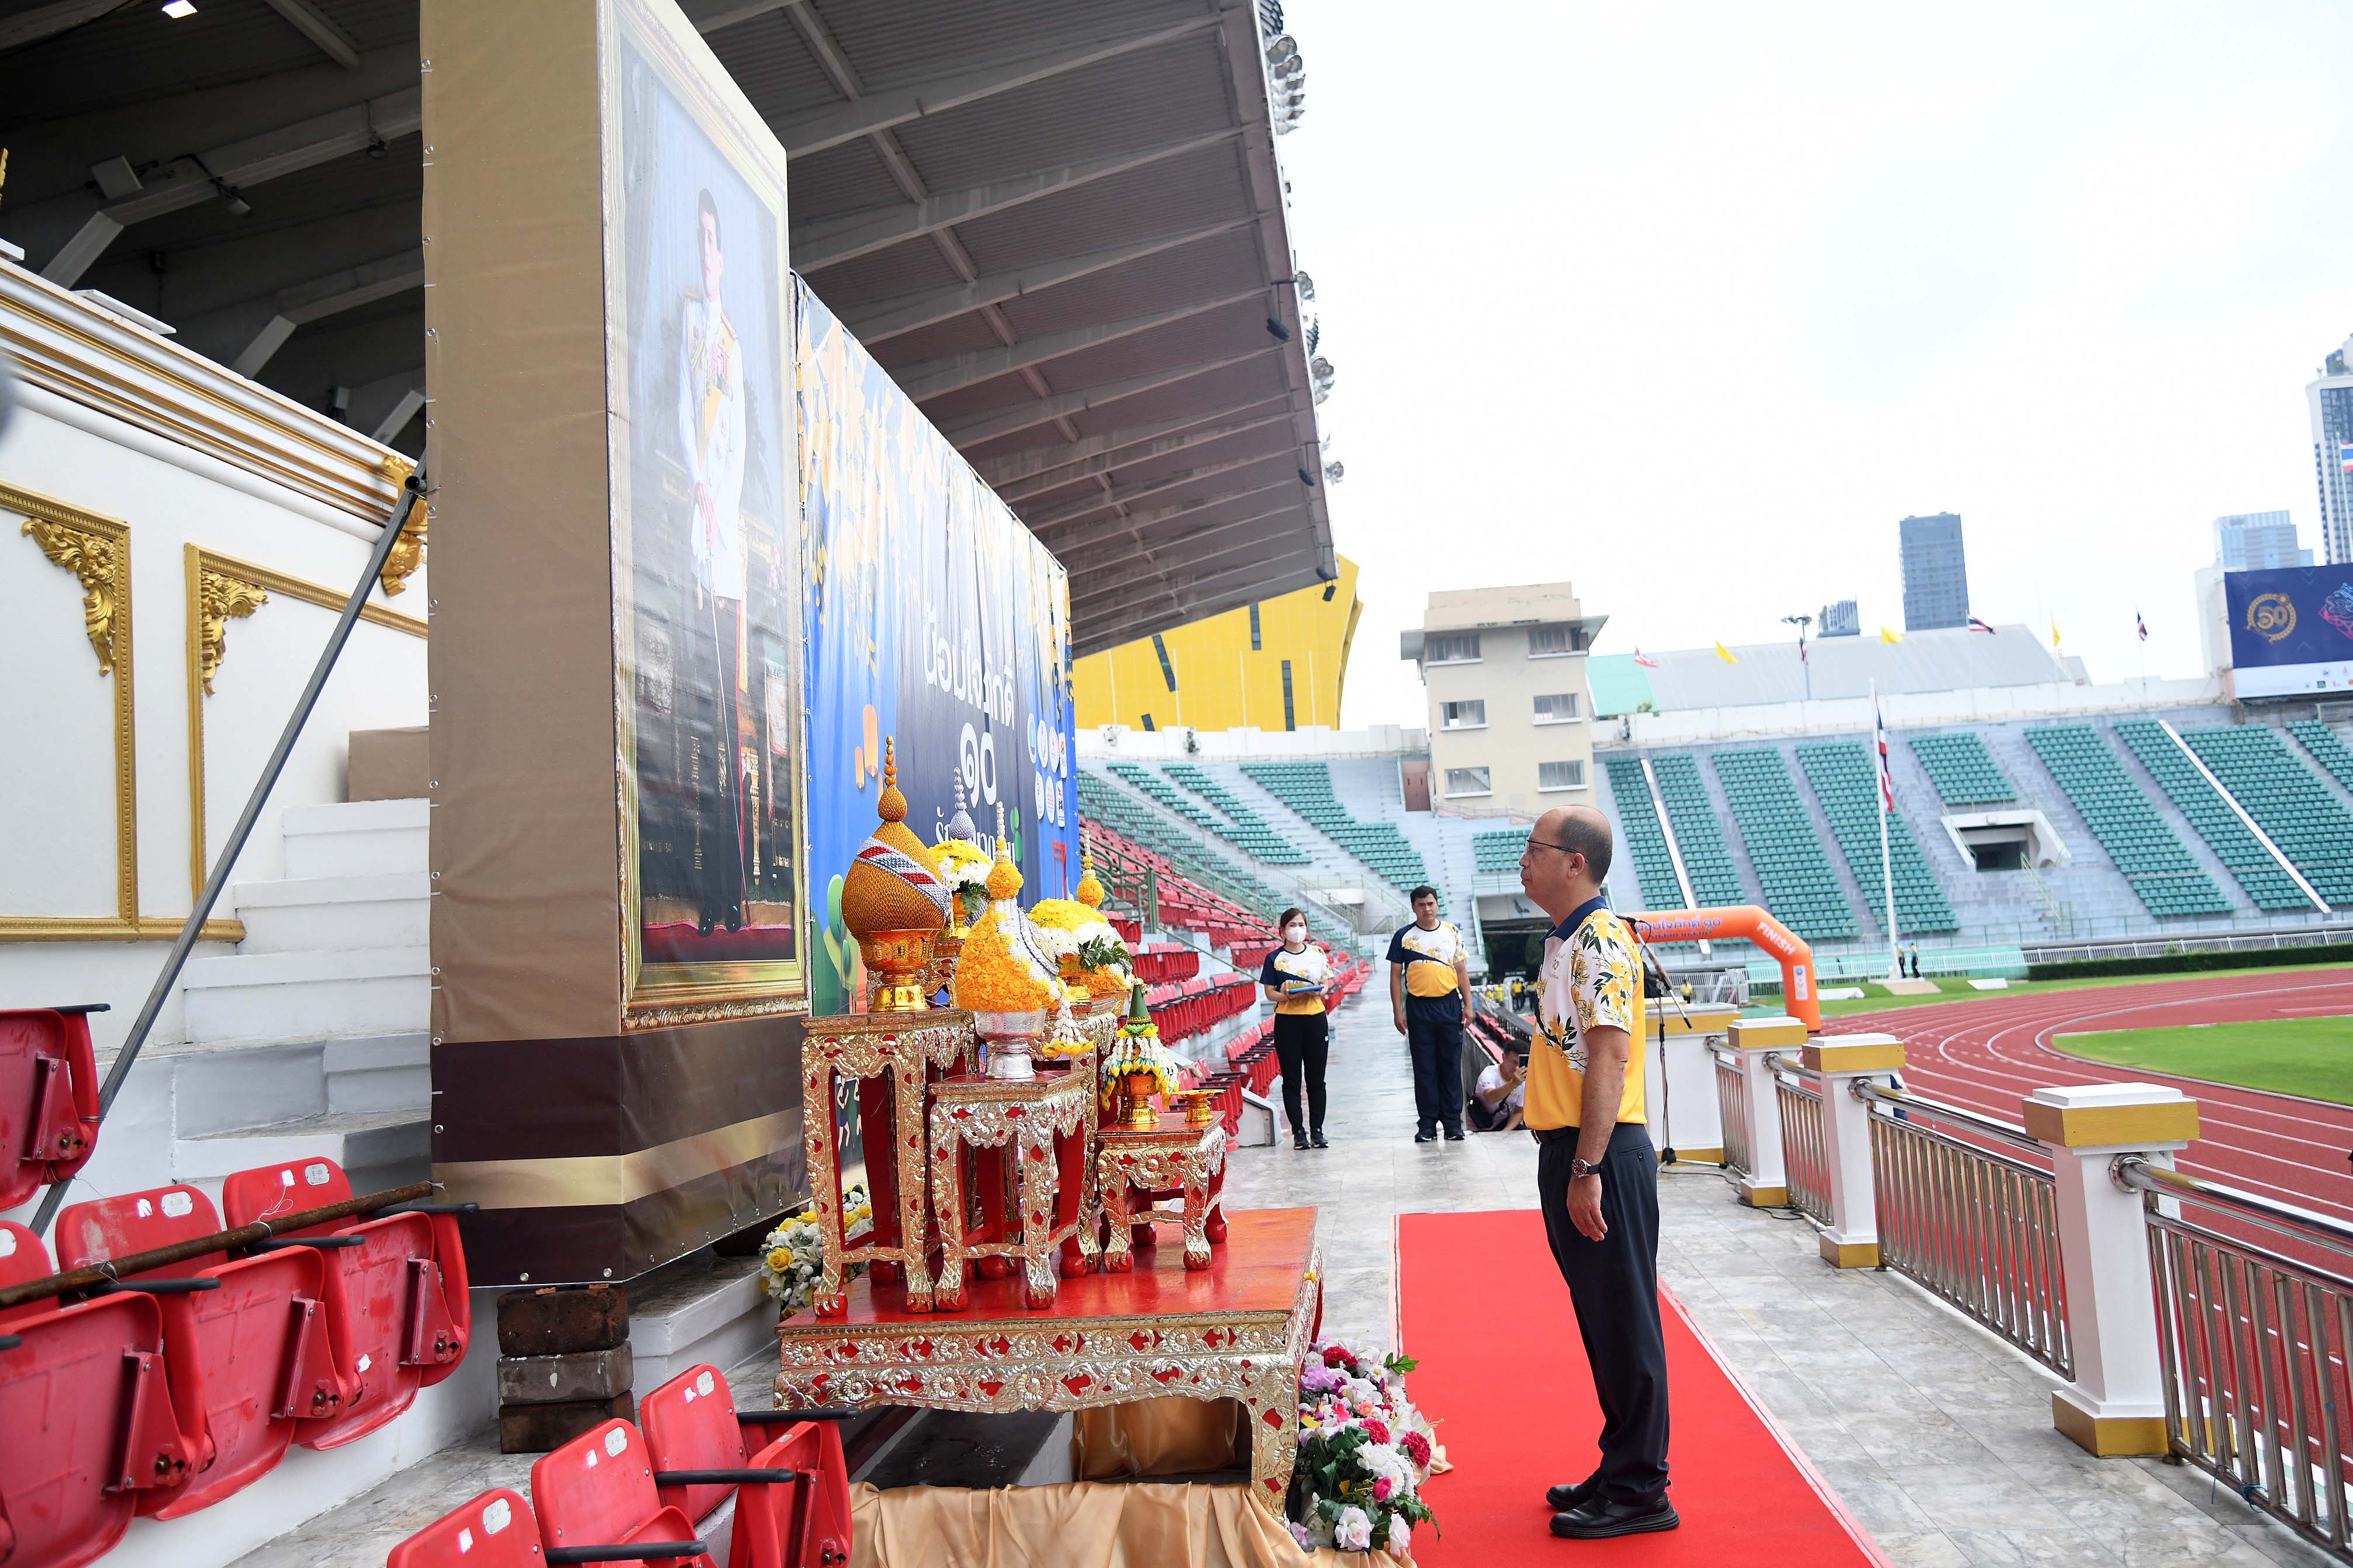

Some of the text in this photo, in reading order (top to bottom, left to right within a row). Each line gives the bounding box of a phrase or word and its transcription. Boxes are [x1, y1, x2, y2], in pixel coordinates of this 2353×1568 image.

[2257, 605, 2288, 629] 50
[960, 722, 996, 808] ๑๐
[1756, 921, 1796, 956] FINISH
